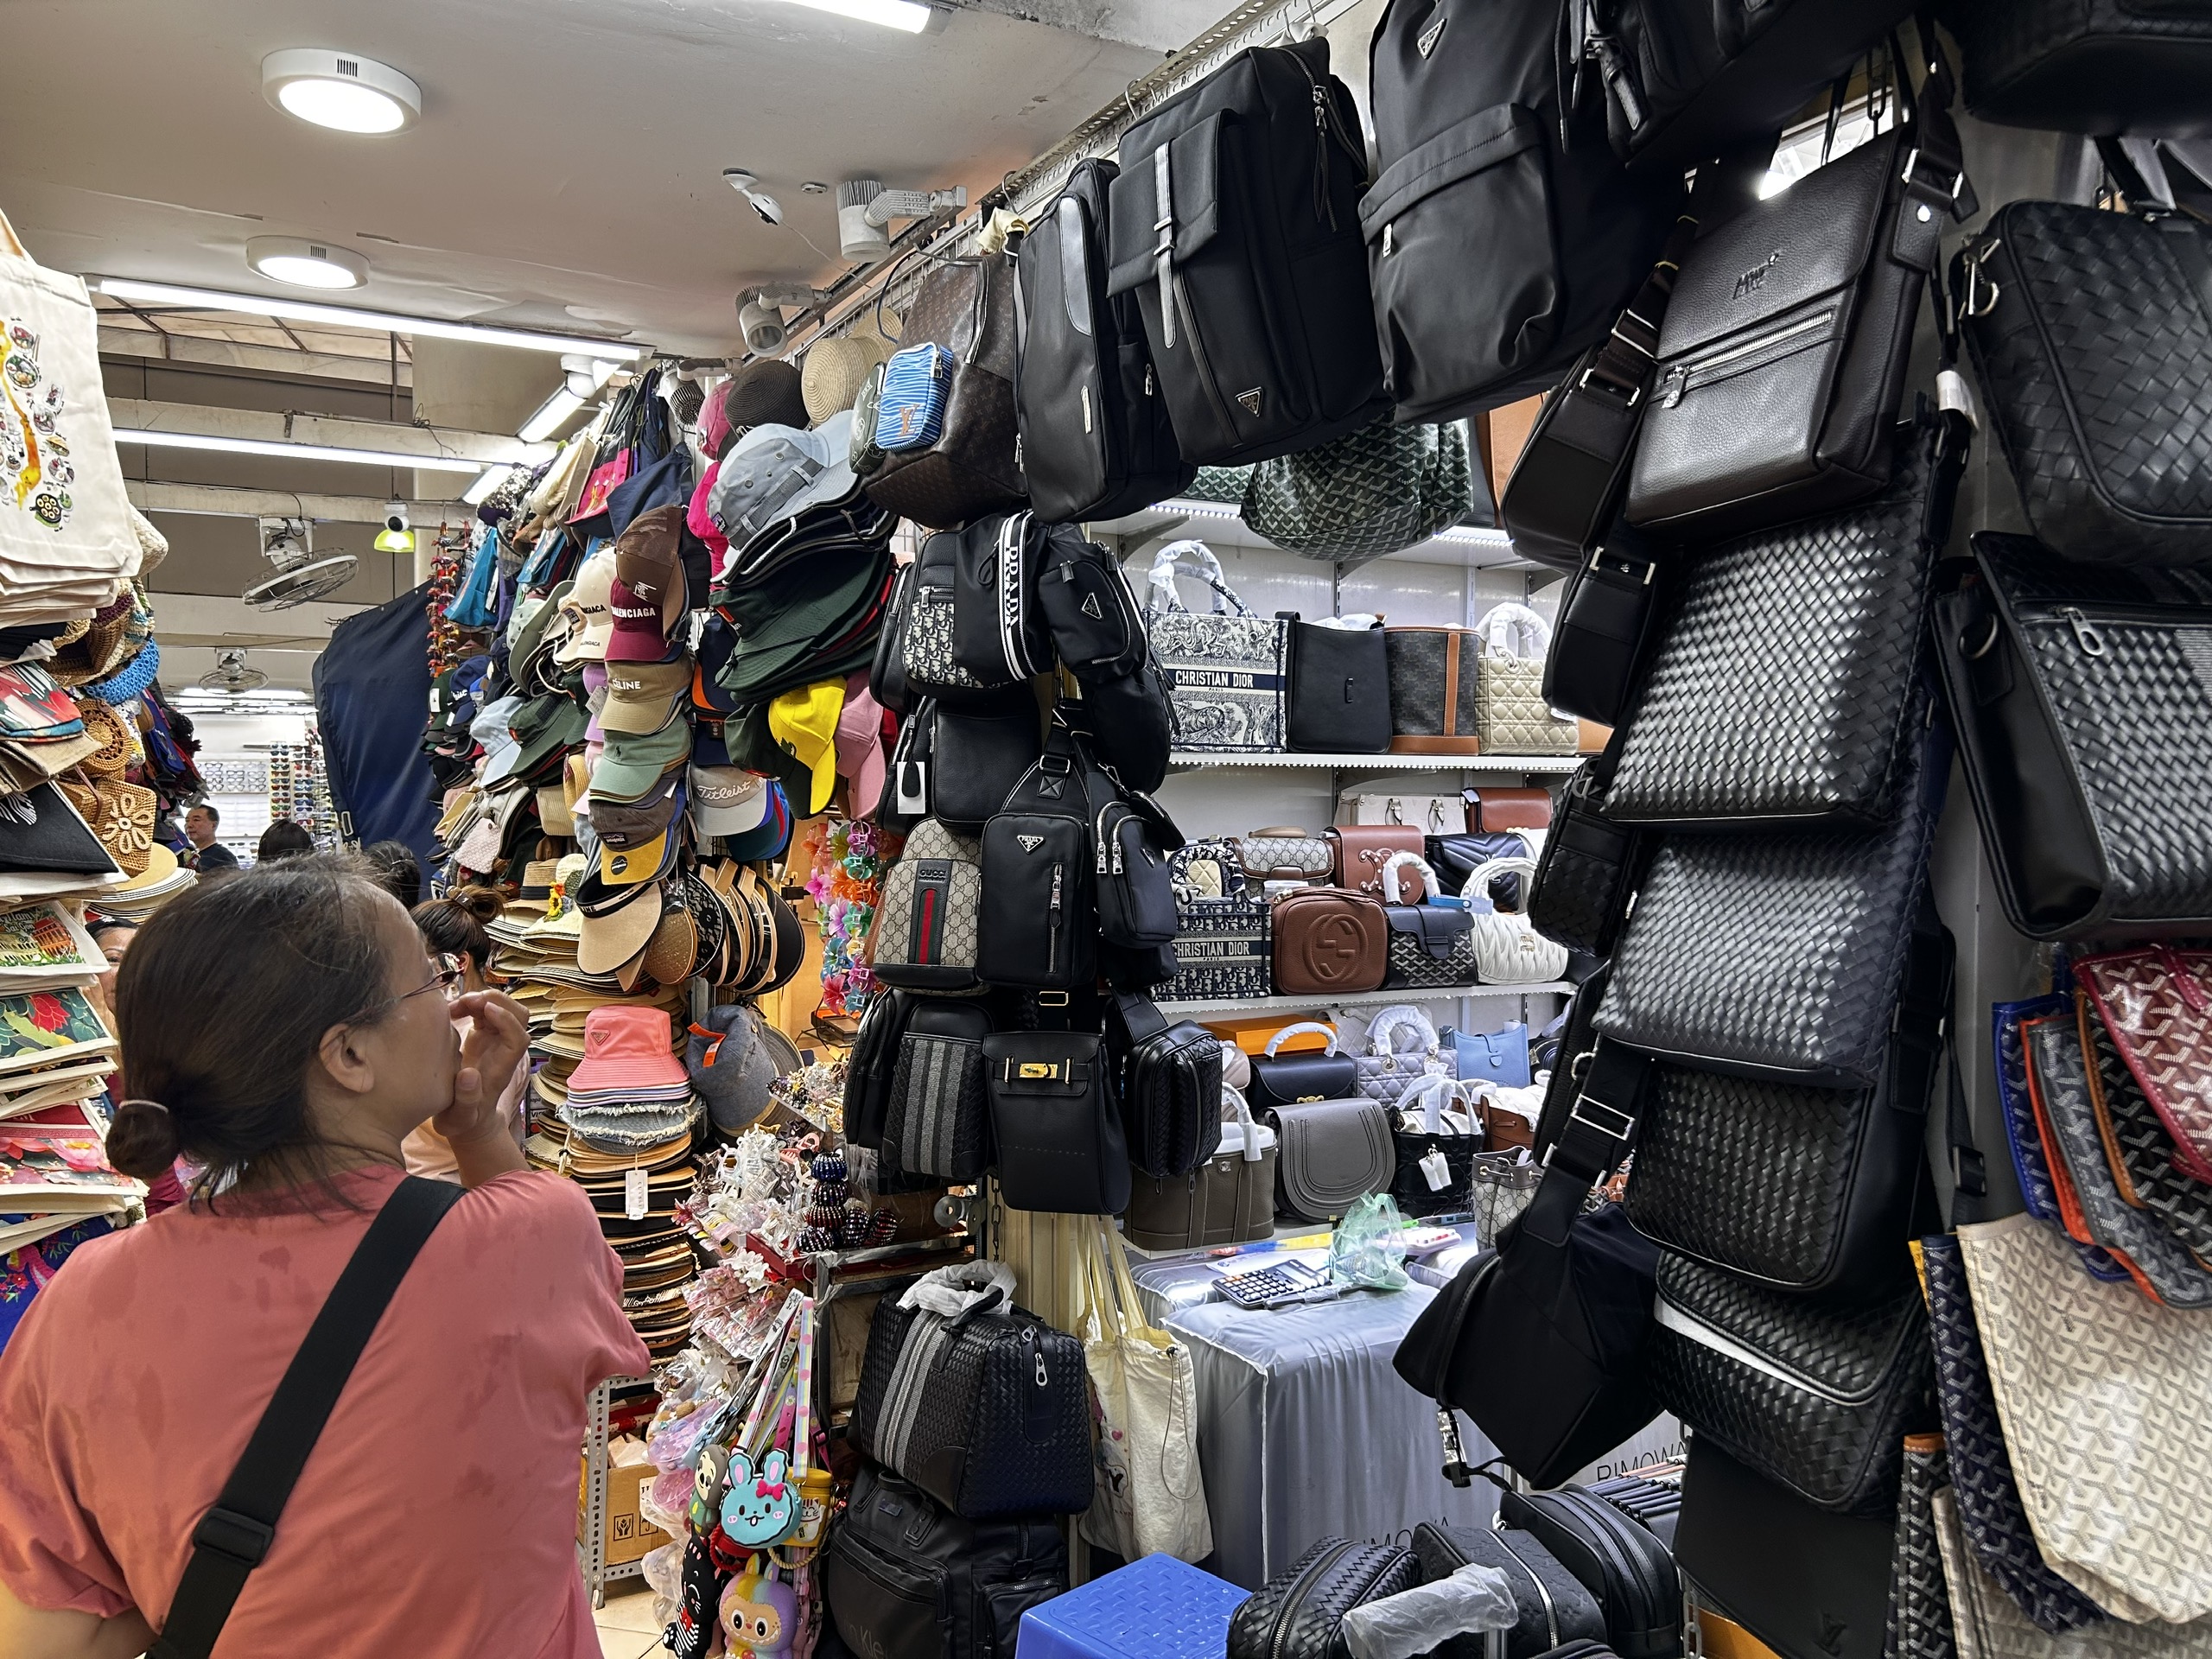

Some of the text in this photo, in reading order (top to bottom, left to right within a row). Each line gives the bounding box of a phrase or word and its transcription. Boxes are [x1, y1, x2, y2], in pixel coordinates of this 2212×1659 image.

[1005, 546, 1019, 631] PRADA
[1175, 670, 1254, 688] CHRISTIAN DIOR
[697, 781, 751, 800] Titleist
[1228, 941, 1250, 956] DIOR
